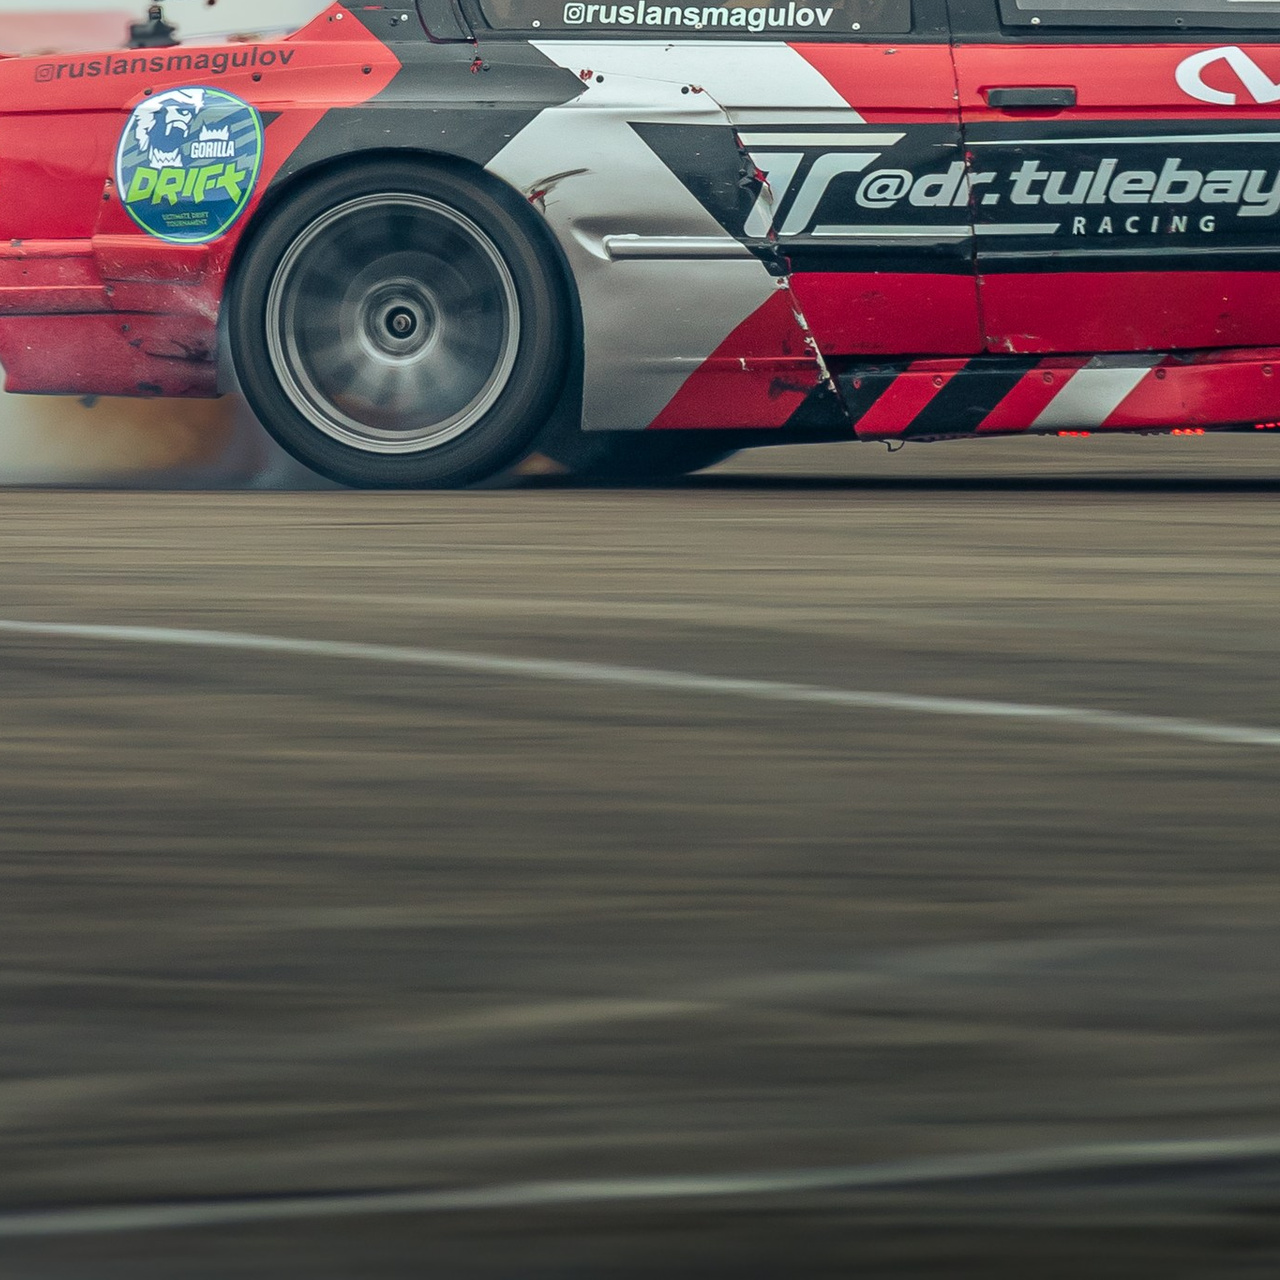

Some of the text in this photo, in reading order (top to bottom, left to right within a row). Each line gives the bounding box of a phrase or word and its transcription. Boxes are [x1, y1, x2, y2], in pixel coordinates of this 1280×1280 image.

[586, 0, 834, 32] ruslansmagulov
[55, 47, 295, 78] ruslansmagulov
[190, 140, 235, 158] GORILLA
[1072, 215, 1216, 235] RACING
